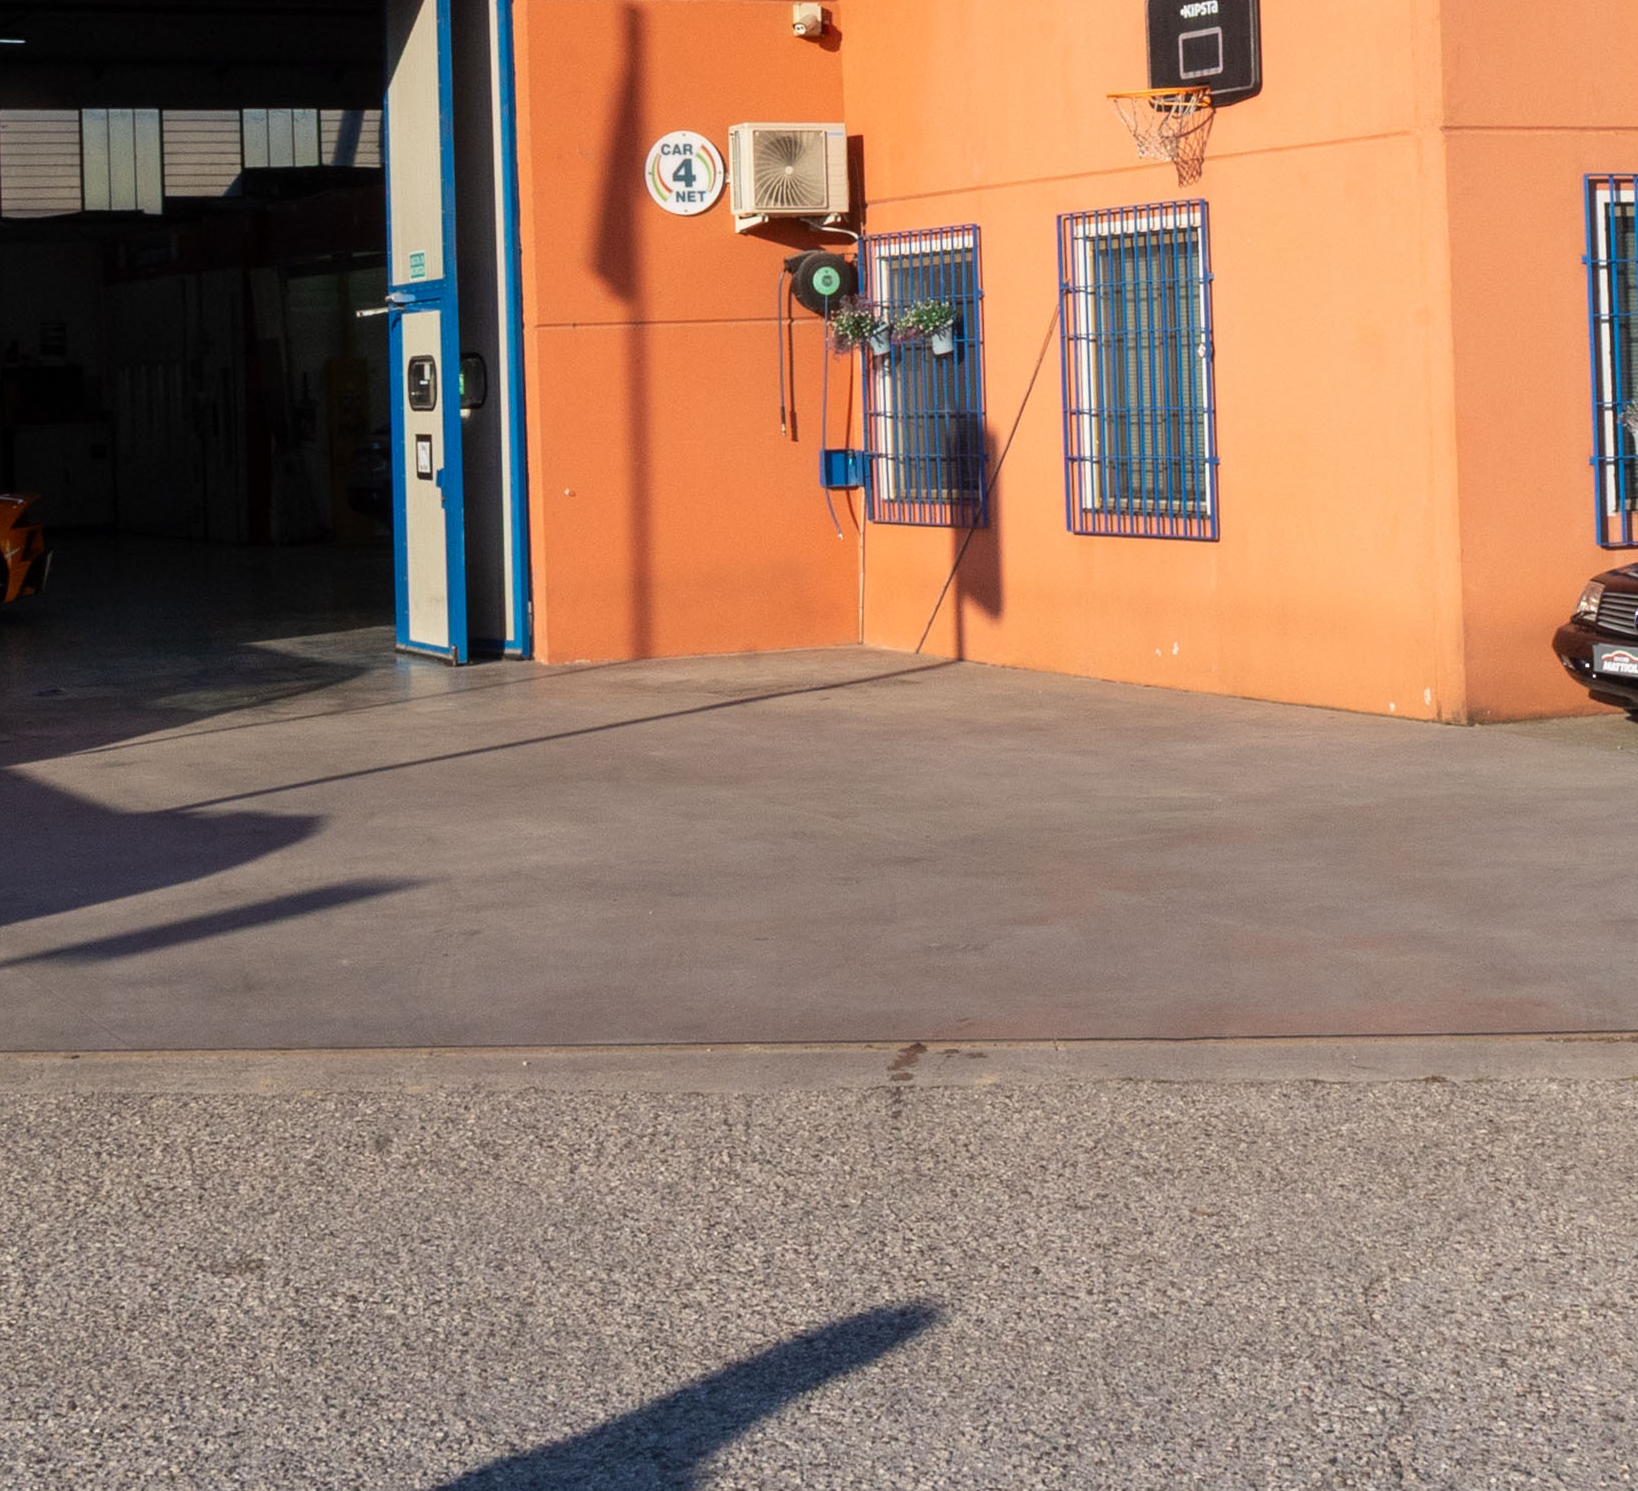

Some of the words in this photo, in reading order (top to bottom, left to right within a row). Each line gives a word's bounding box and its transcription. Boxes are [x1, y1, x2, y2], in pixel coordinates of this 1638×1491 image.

[660, 143, 694, 157] CAR
[671, 158, 697, 188] 4
[675, 190, 707, 204] NET
